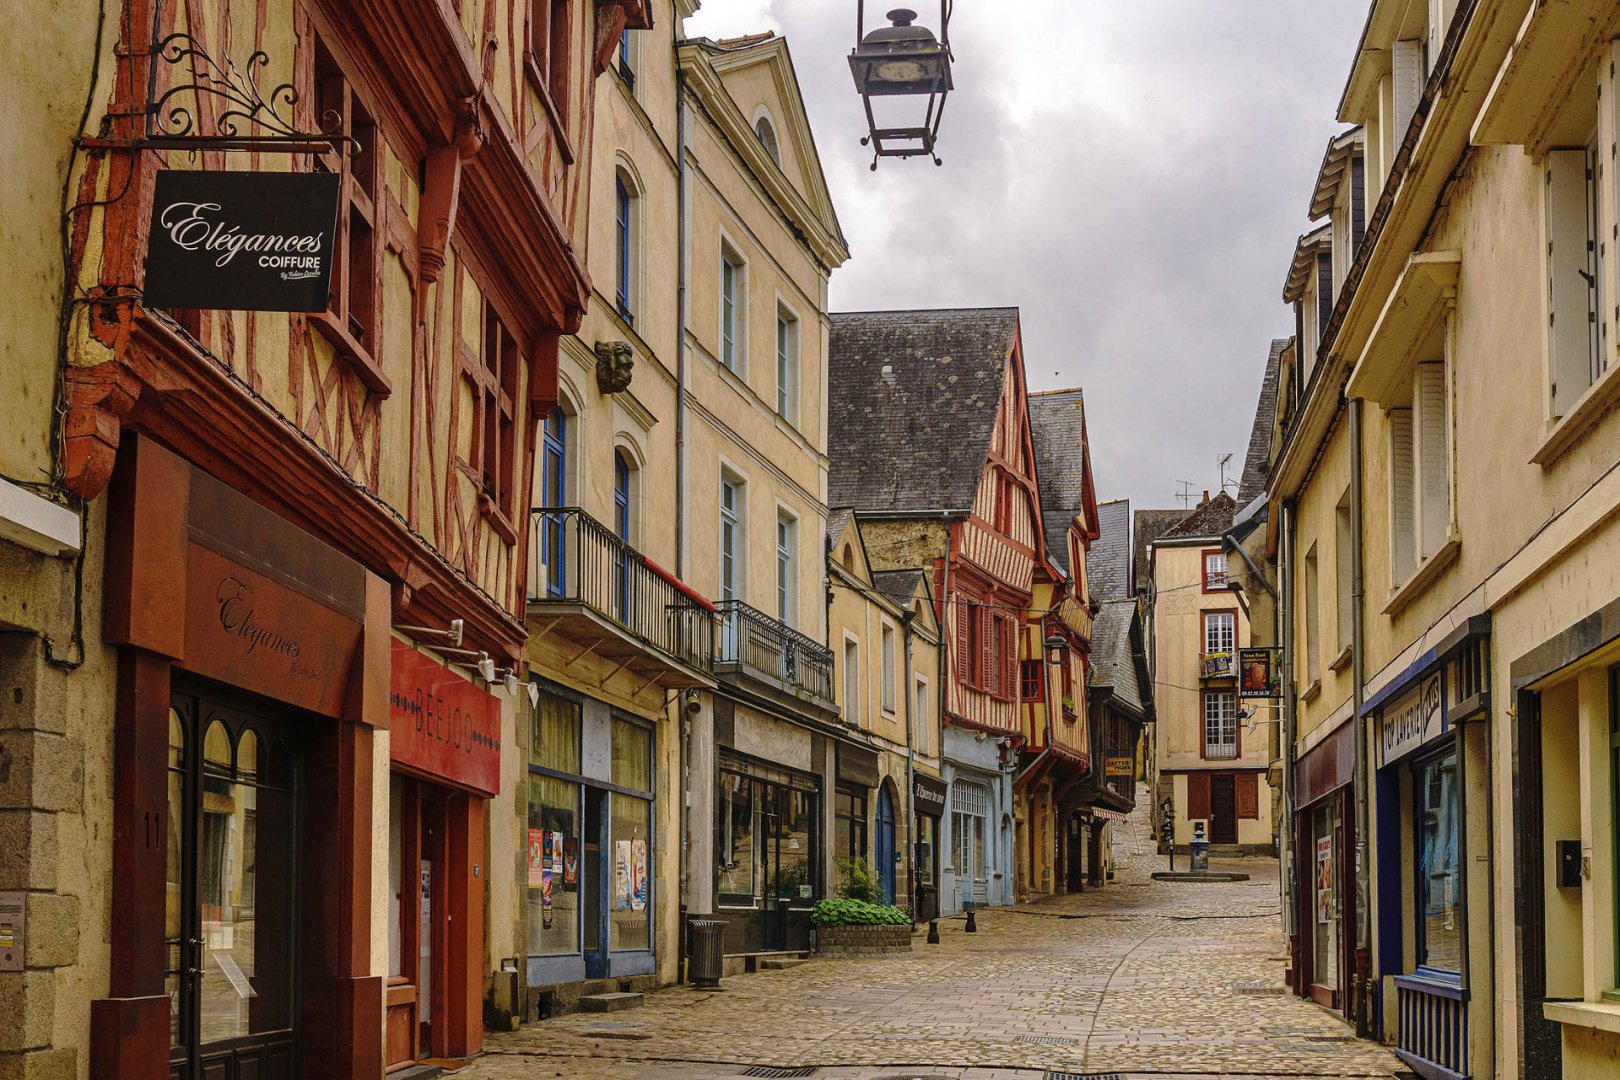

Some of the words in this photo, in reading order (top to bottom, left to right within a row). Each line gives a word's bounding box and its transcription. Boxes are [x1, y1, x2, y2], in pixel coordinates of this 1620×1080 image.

[161, 202, 323, 267] Elégances
[258, 256, 321, 269] COIFFURE
[416, 687, 472, 754] BEEJOO
[1384, 717, 1395, 751] TOP
[1396, 704, 1420, 745] LAVERIE
[1423, 681, 1439, 724] PLUS
[144, 811, 160, 849] 11
